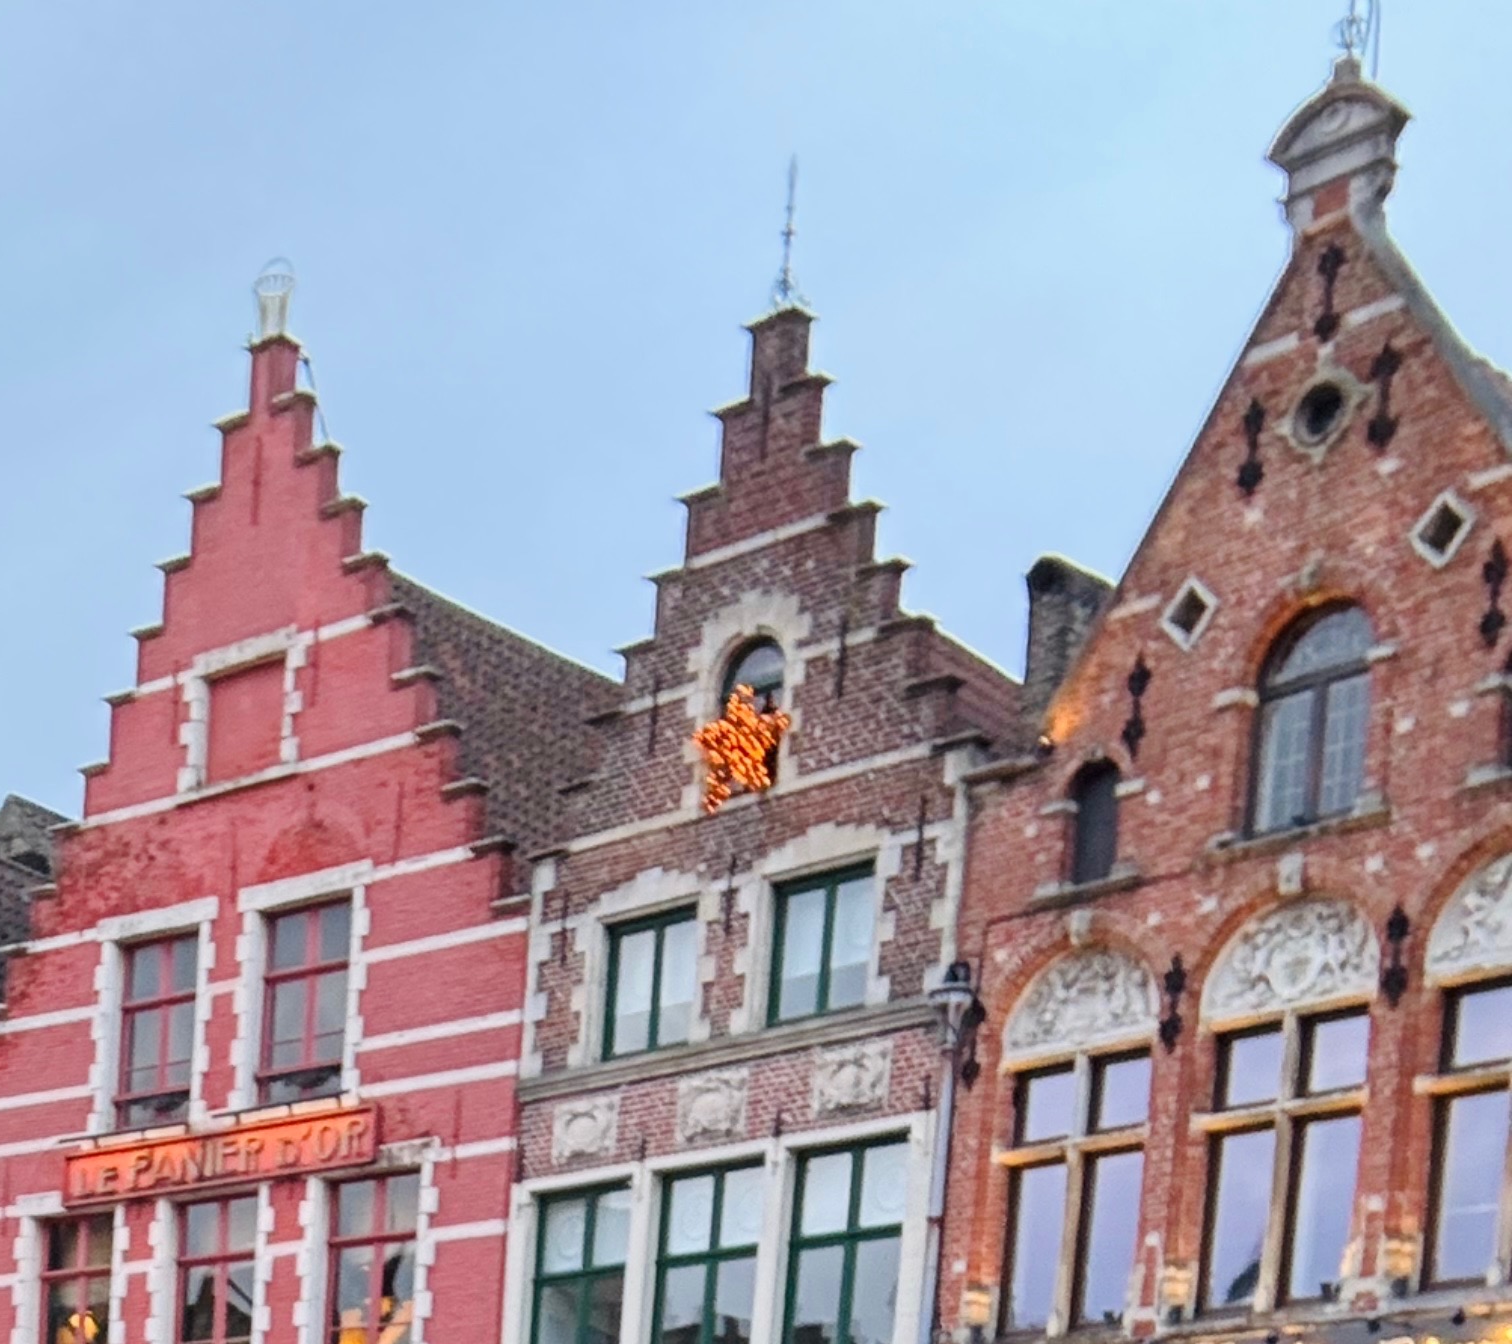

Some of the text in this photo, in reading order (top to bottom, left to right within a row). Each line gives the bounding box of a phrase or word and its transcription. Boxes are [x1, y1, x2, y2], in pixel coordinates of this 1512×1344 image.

[71, 1119, 369, 1198] LE PANIER D'OR
